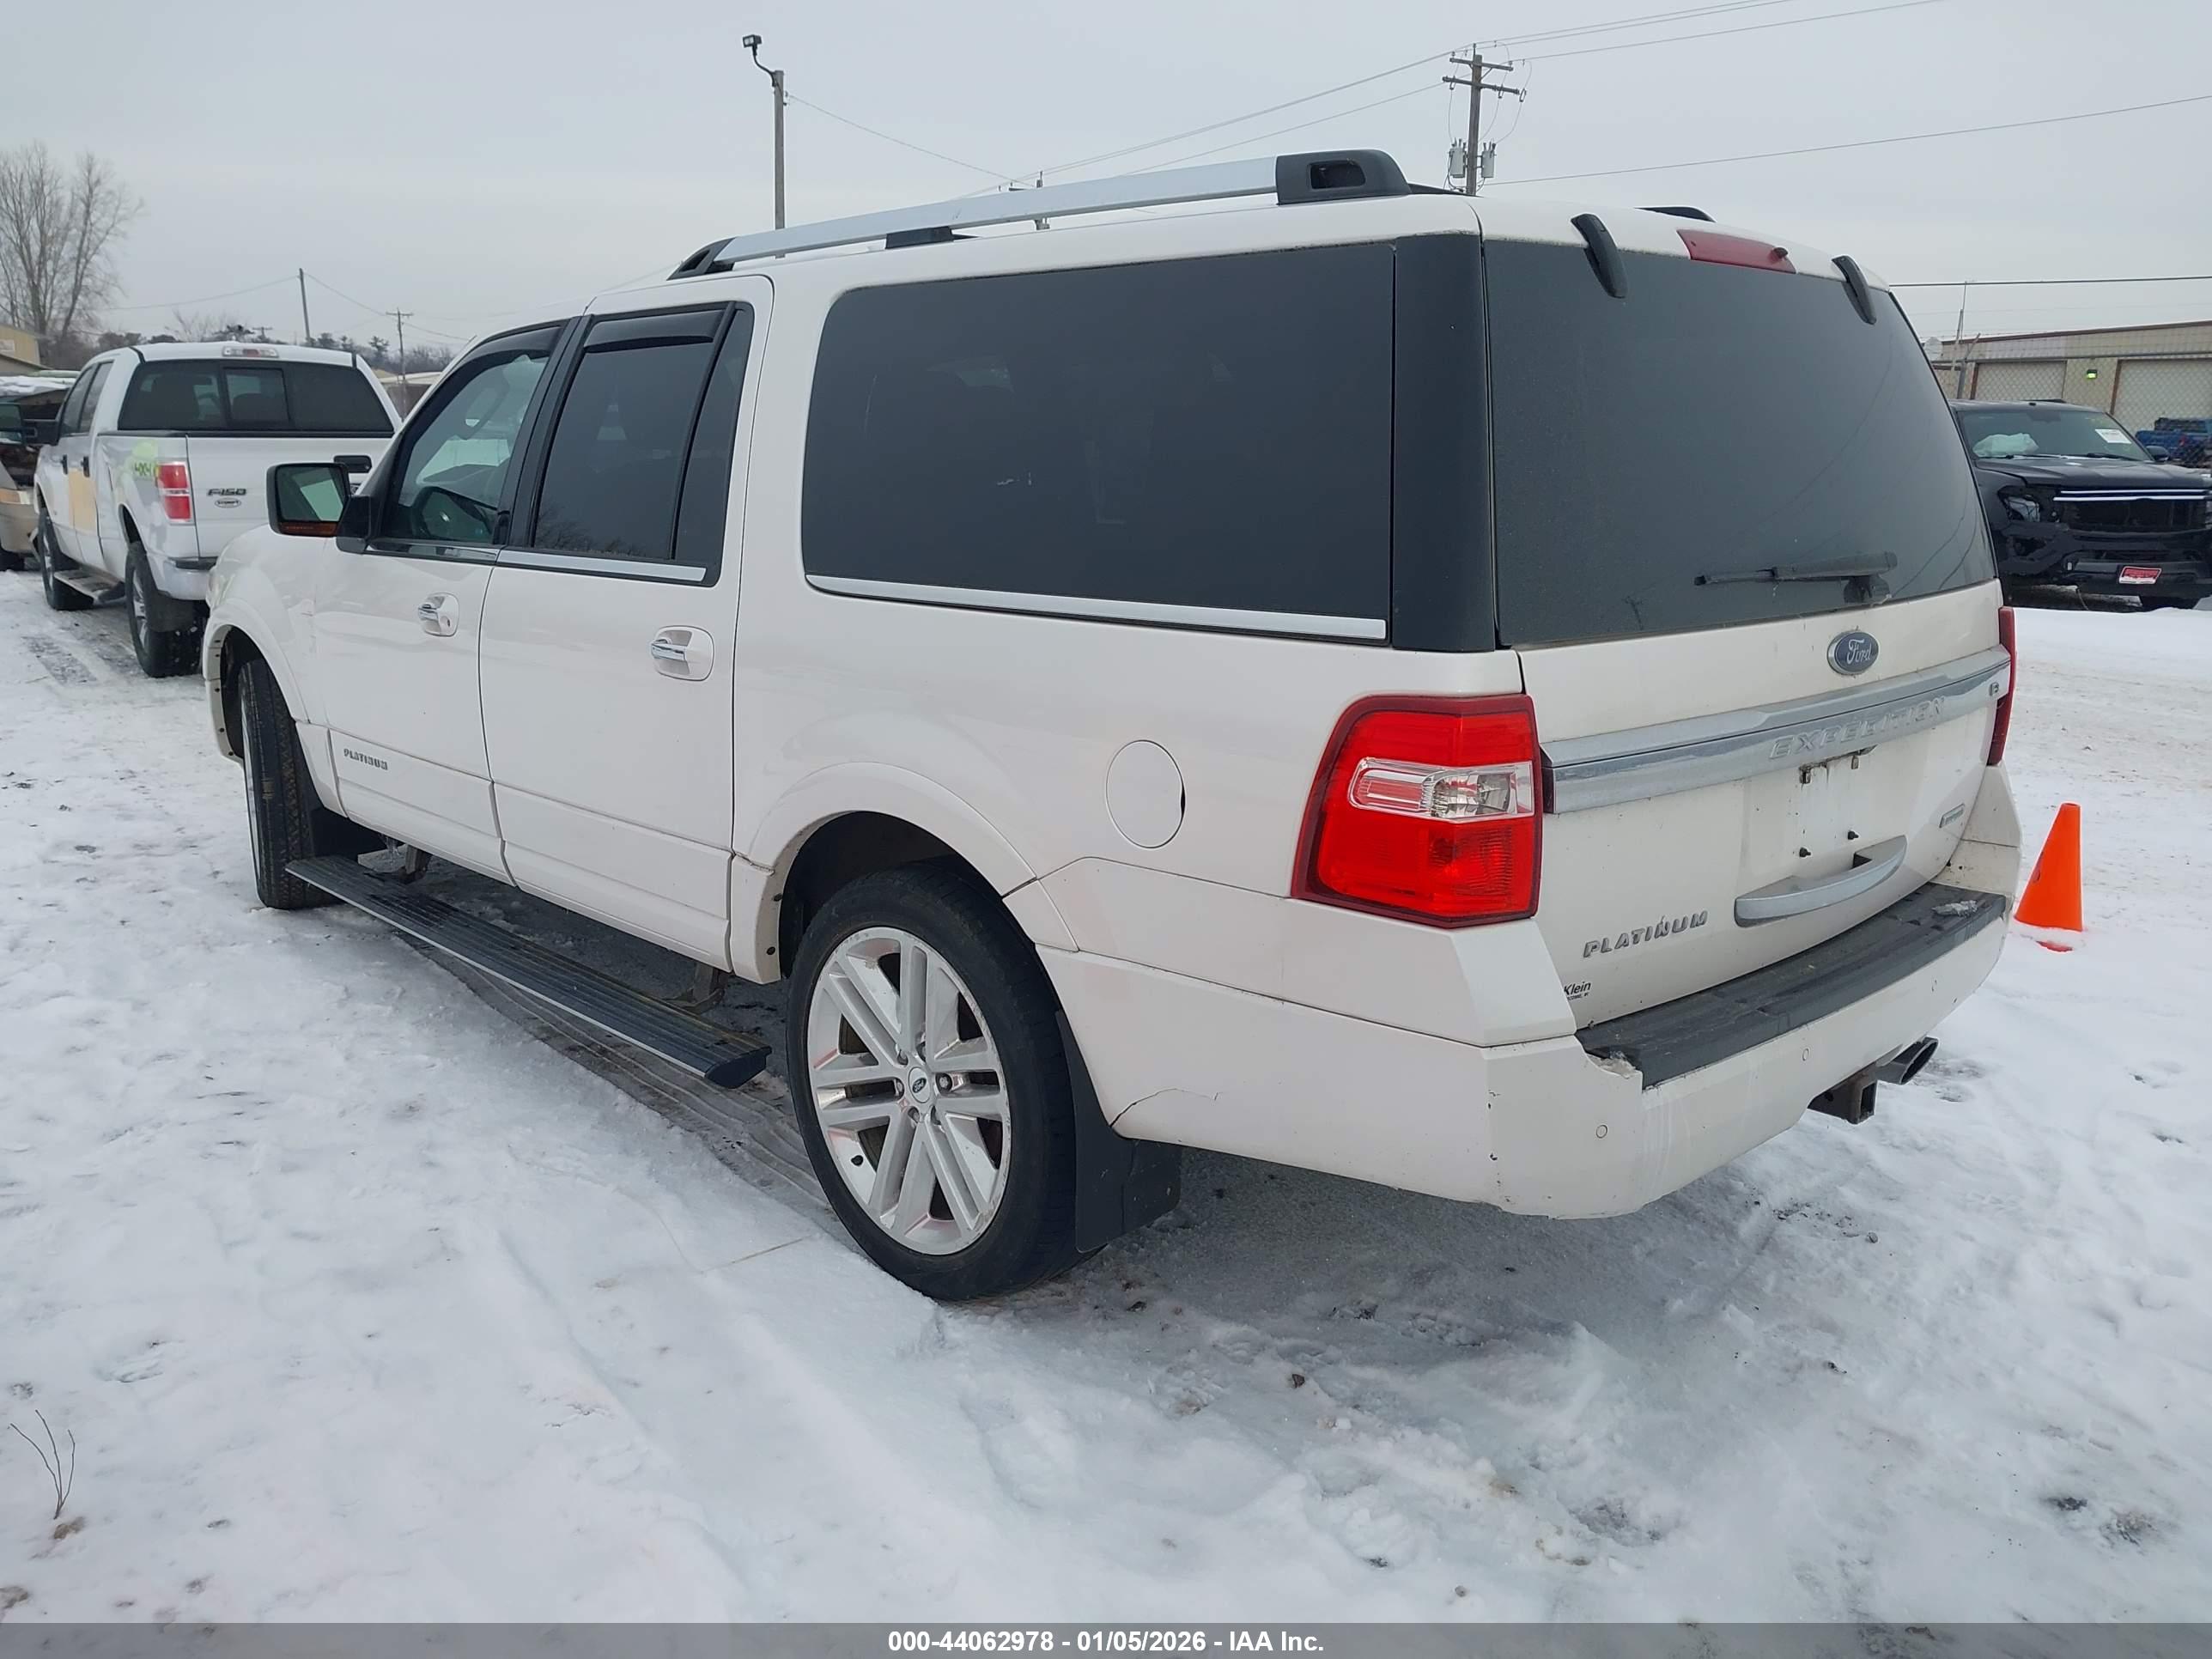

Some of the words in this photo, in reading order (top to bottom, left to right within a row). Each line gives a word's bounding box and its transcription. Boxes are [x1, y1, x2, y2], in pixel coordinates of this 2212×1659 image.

[1846, 638, 1872, 665] Ford
[1769, 695, 1945, 759] EXPEDITION
[343, 748, 388, 770] PLATINUM
[1583, 910, 1708, 958] PLATINUM
[1564, 981, 1591, 995] Klein
